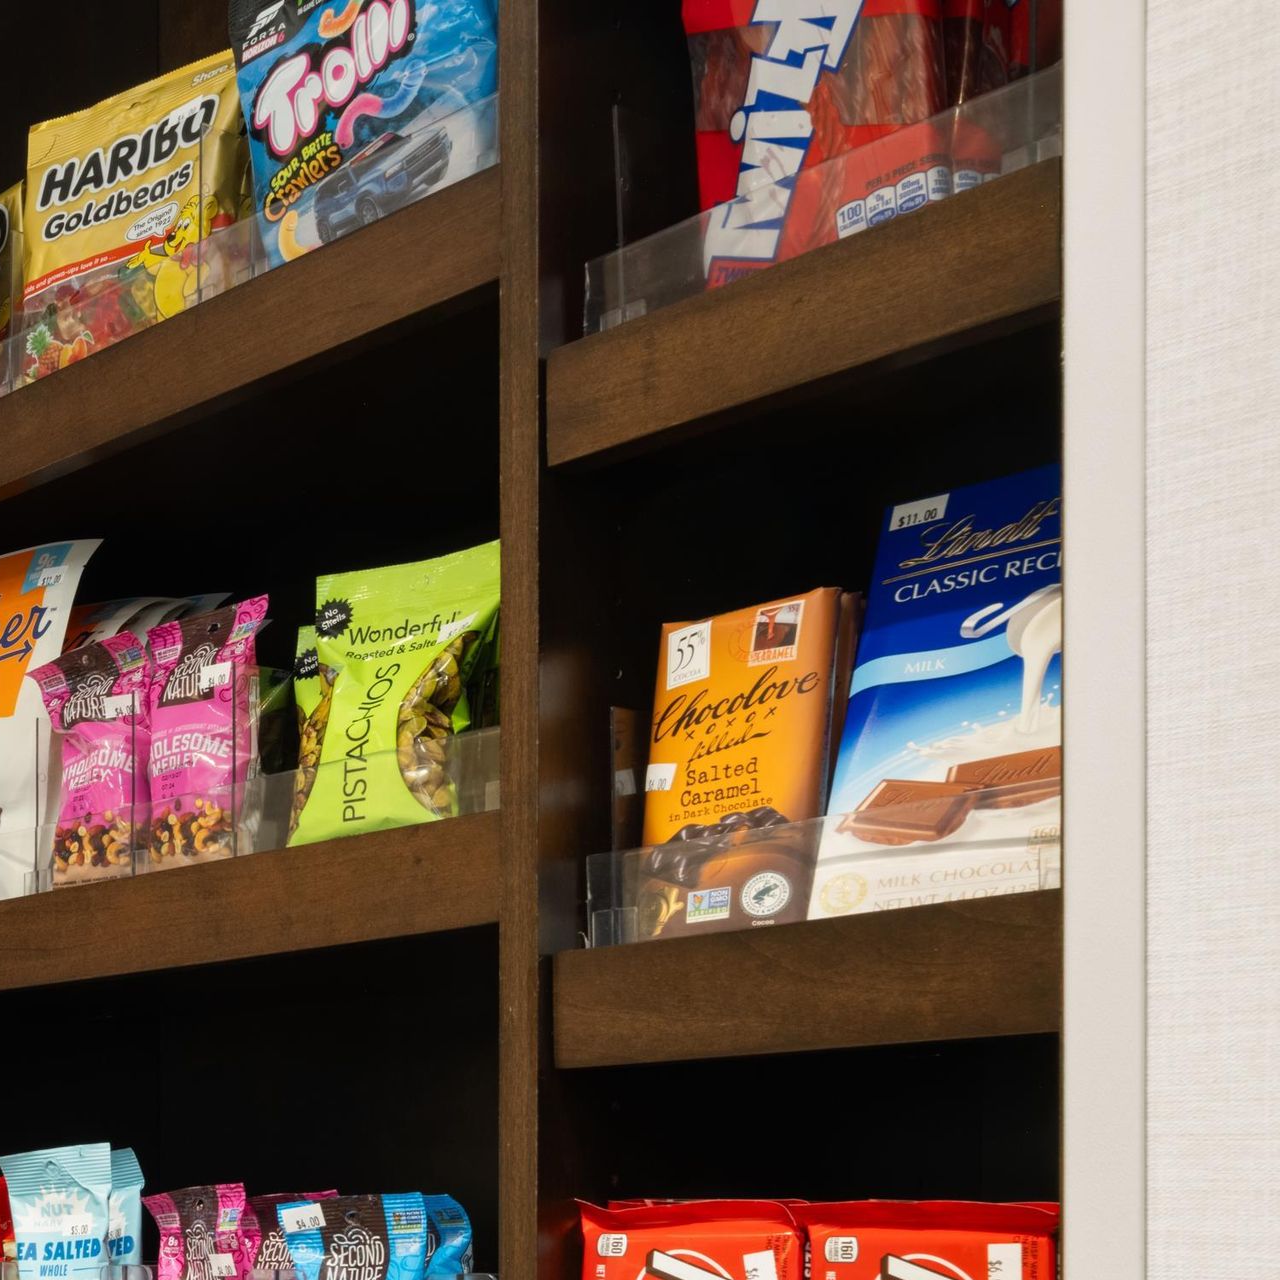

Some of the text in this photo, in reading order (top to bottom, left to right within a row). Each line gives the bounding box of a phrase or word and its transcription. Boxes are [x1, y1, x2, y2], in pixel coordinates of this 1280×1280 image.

[242, 23, 287, 48] FORZA
[192, 65, 226, 87] Share
[271, 132, 333, 192] SOUR BRITE
[264, 145, 342, 222] Crawlers
[43, 161, 194, 242] Goldbears
[840, 202, 863, 224] 100
[133, 206, 174, 233] The Original
[136, 215, 172, 238] since 1922
[46, 265, 79, 285] grown-ups
[897, 507, 939, 528] $11.00
[898, 498, 1061, 568] Lindt
[894, 550, 1062, 604] CLASSIC RECI
[320, 612, 347, 632] Shells
[324, 606, 339, 620] No
[303, 654, 318, 666] No
[904, 657, 947, 676] MILK
[654, 664, 822, 744] Chocolove
[342, 663, 401, 823] PISTACHIOS
[685, 722, 772, 772] filled
[151, 752, 198, 779] MEDLEY
[685, 757, 759, 786] Salted
[680, 778, 761, 808] Caramel
[668, 795, 774, 823] in Dark Chocolate
[877, 858, 1054, 891] MILK CHOCOLATE
[41, 1202, 74, 1217] NUT
[70, 1224, 89, 1236] $5.00
[296, 1215, 321, 1230] $4.00
[42, 1238, 102, 1261] SALTED
[327, 1235, 385, 1267] SECOND
[610, 1236, 624, 1256] 160
[840, 1238, 854, 1260] 160
[39, 1264, 68, 1278] WHOLE
